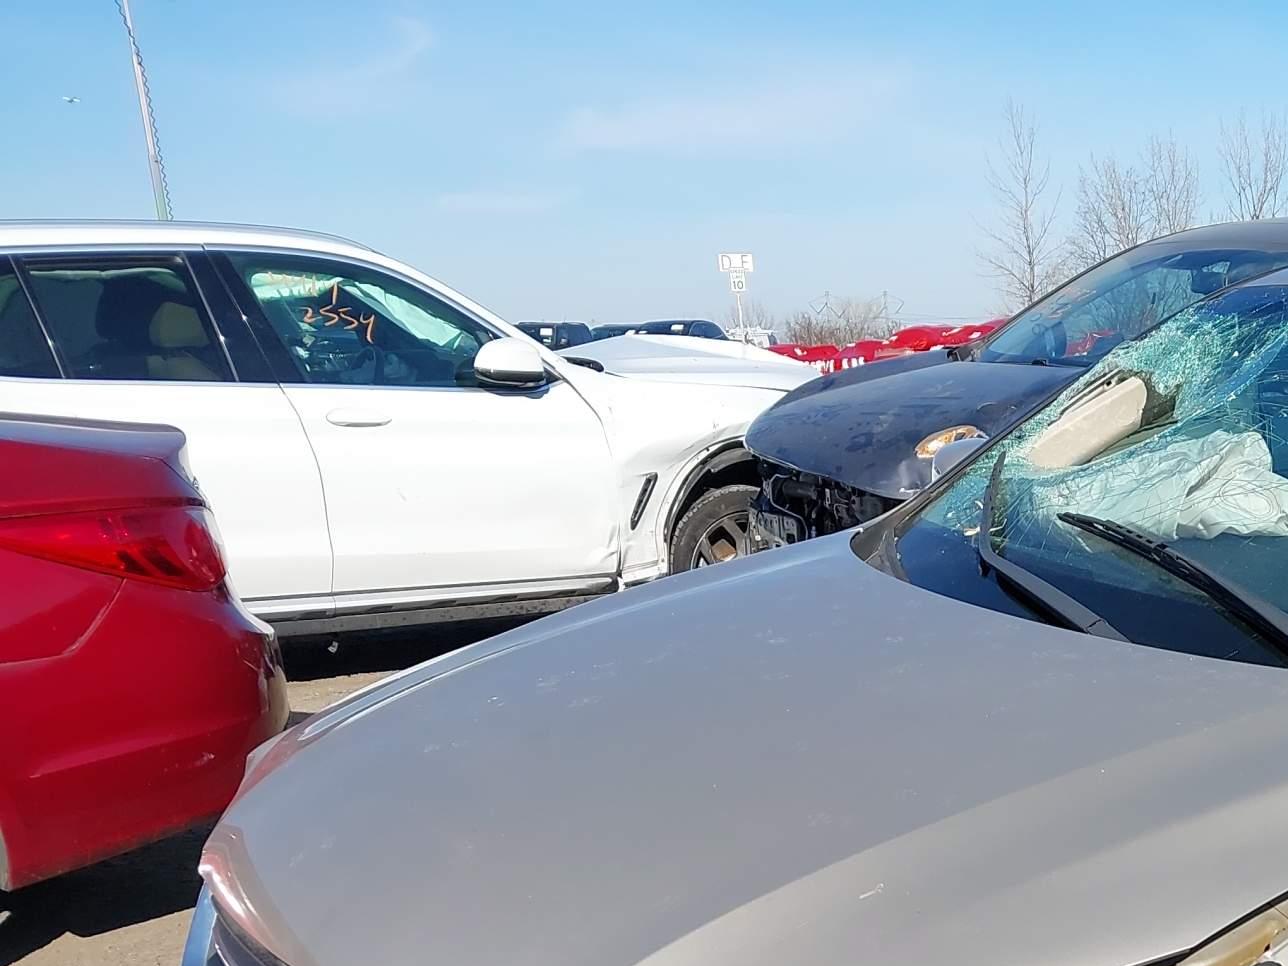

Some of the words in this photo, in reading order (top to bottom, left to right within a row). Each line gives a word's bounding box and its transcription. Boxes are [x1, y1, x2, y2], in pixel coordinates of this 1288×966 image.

[721, 254, 732, 270] D
[732, 280, 744, 290] 10
[299, 304, 376, 344] 2554
